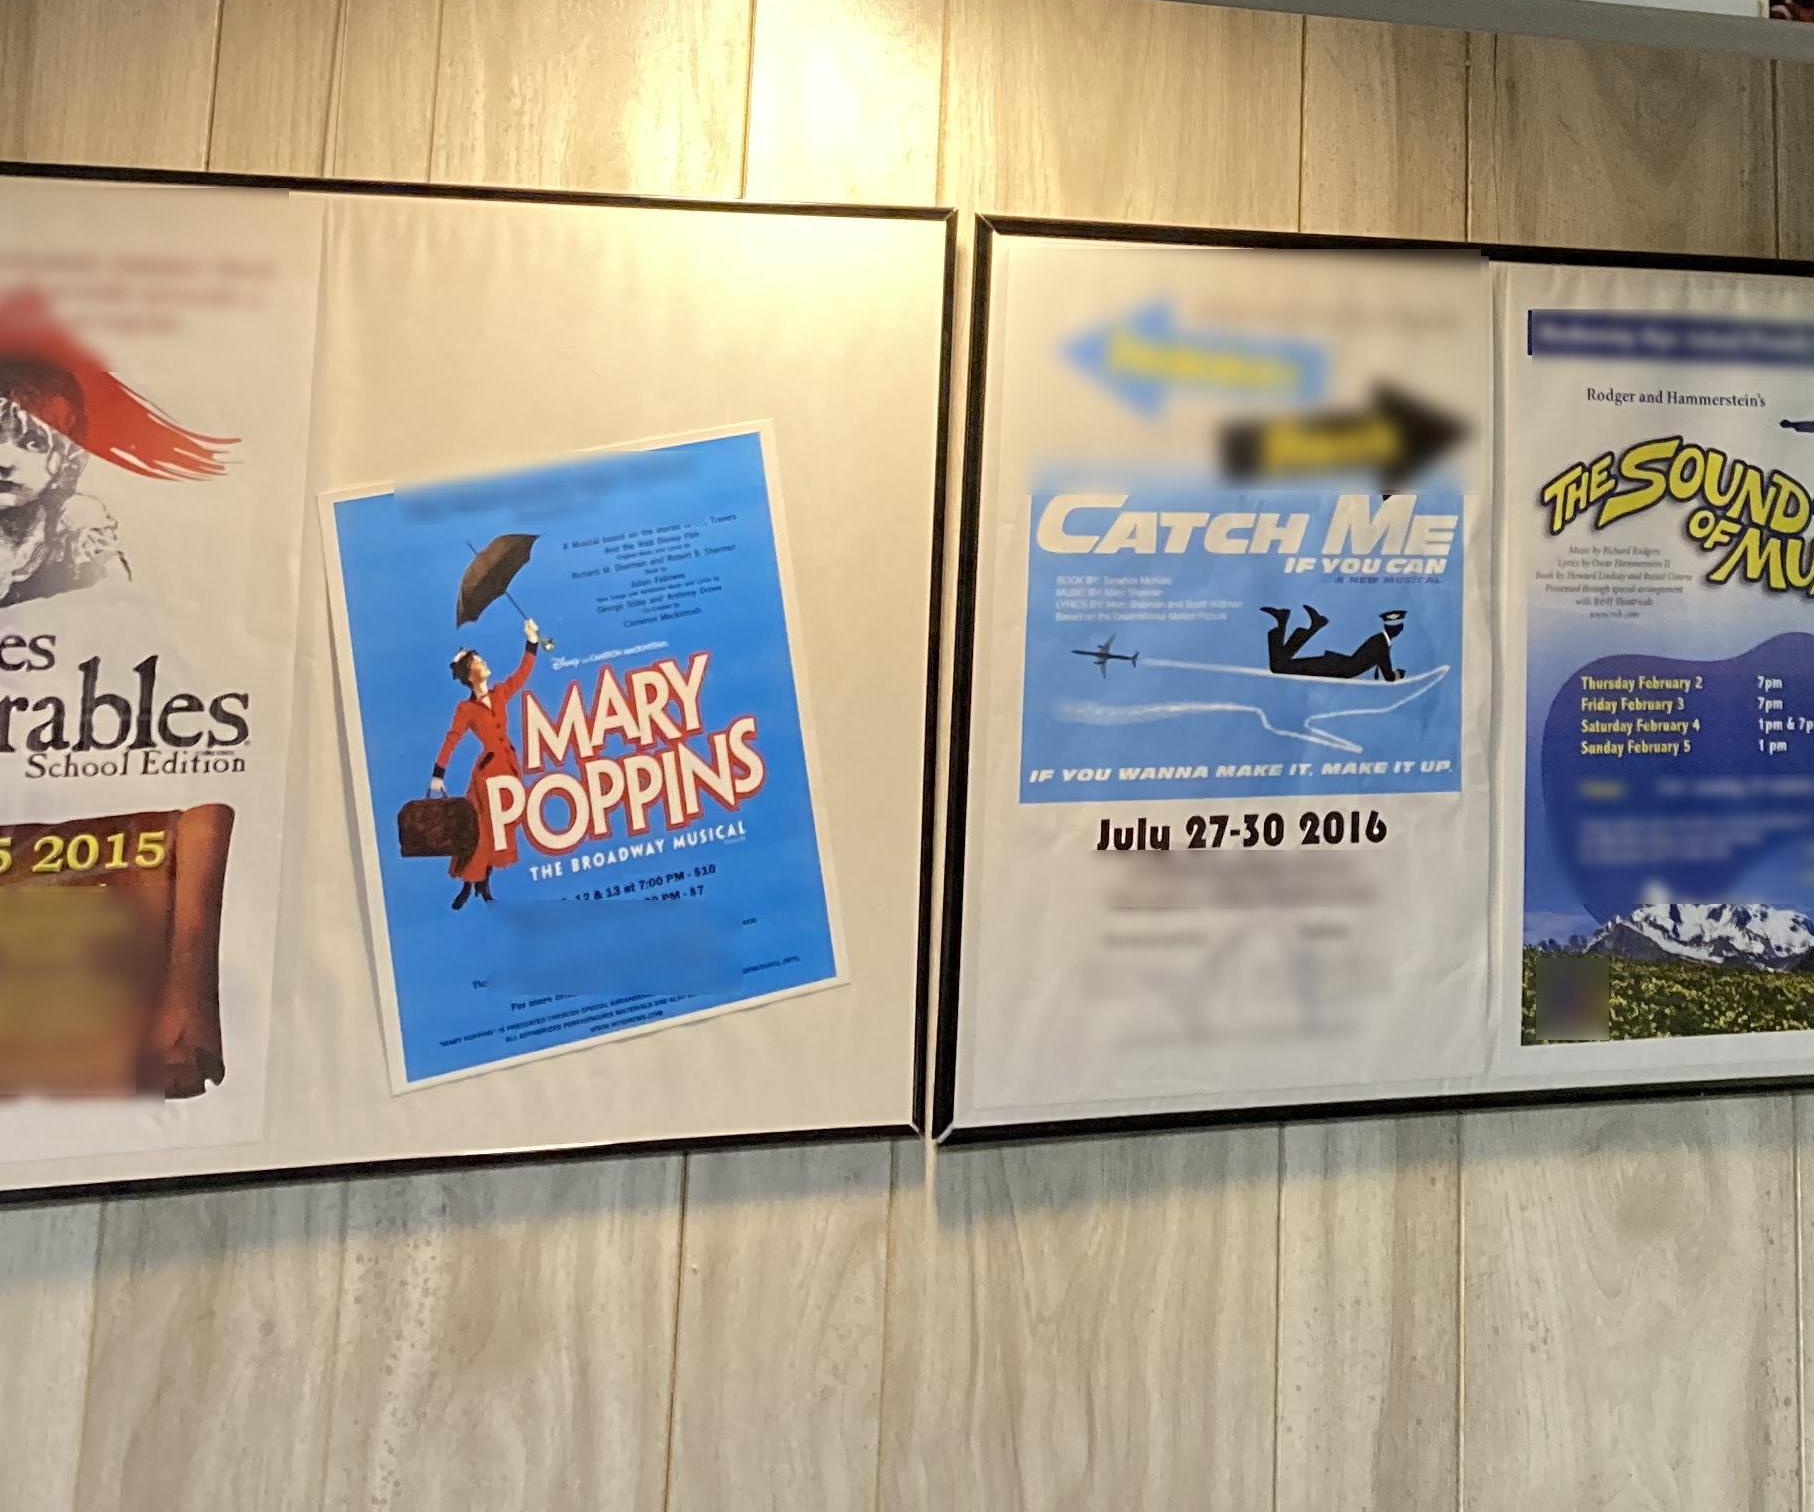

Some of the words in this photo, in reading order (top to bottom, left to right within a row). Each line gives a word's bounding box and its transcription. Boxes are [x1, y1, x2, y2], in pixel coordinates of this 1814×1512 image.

[1586, 387, 1635, 404] Rodger
[1639, 389, 1663, 404] and
[1666, 390, 1766, 408] Hammerstein's
[1541, 451, 1617, 536] THE
[1595, 435, 1813, 534] SOUND
[1036, 494, 1310, 555] CATCH
[1321, 494, 1458, 556] ME
[1685, 507, 1741, 552] OF
[1284, 557, 1319, 574] IF
[1322, 557, 1382, 574] YOU
[1385, 558, 1447, 574] CAN
[1581, 675, 1635, 692] Thursday
[1638, 675, 1691, 692] February
[1695, 676, 1703, 689] 2
[1757, 675, 1783, 691] 7pm
[524, 653, 711, 771] MARY
[1581, 696, 1618, 713] Friday
[1621, 696, 1674, 714] February
[1677, 697, 1685, 710] 3
[1757, 696, 1783, 712] 7pm
[25, 750, 130, 779] School
[140, 750, 246, 776] Edition
[1581, 740, 1624, 756] Sunday
[1627, 740, 1679, 756] February
[1683, 740, 1691, 753] 5
[483, 716, 765, 854] POPPINS
[1029, 769, 1055, 783] IF
[1061, 768, 1109, 783] YOU
[1119, 765, 1209, 780] WANNA
[1216, 763, 1284, 778] MAKE
[1321, 761, 1388, 776] MAKE
[1393, 760, 1417, 775] IT
[1096, 817, 1170, 851] July
[1186, 813, 1284, 849] 27-30
[1299, 810, 1388, 845] 2016
[31, 830, 167, 873] 2015
[529, 863, 563, 882] THE
[571, 838, 665, 873] BROADWAY
[673, 820, 747, 850] MUSICAL
[606, 886, 621, 899] 13
[638, 875, 664, 892] 7:00
[666, 871, 686, 884] PM
